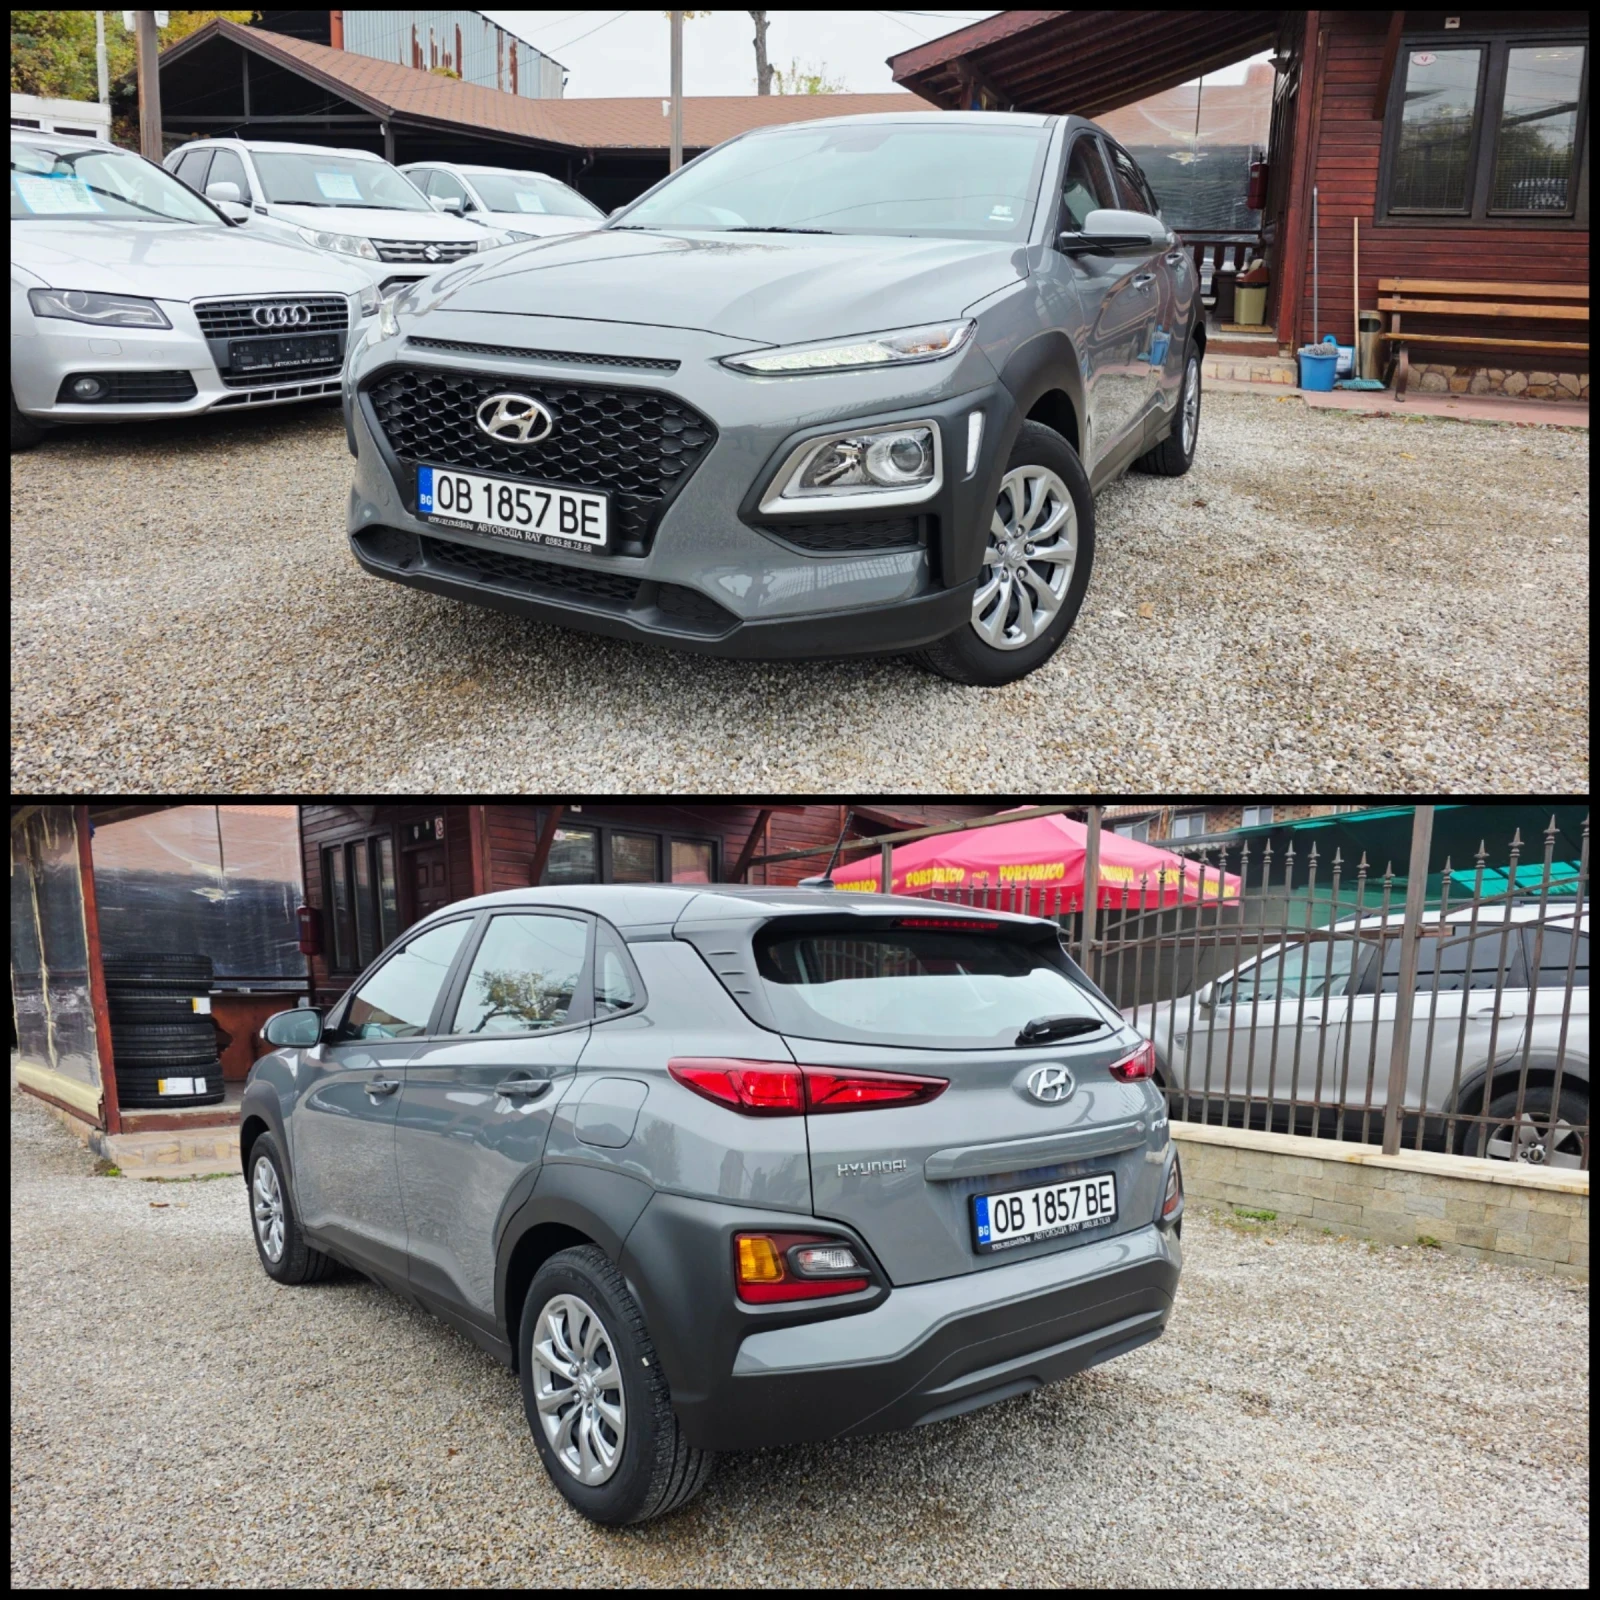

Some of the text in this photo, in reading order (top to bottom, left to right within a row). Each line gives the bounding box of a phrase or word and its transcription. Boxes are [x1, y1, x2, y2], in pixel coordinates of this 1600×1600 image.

[420, 475, 601, 539] BG OB 1857 BE
[525, 530, 543, 545] RAY
[905, 867, 966, 888] PORTORICO
[999, 863, 1065, 882] PORTORICO
[837, 1159, 907, 1177] HYUNDAI
[977, 1225, 990, 1238] BG
[994, 1197, 1025, 1234] OB
[1032, 1186, 1081, 1227] 1857
[1085, 1180, 1112, 1216] BE
